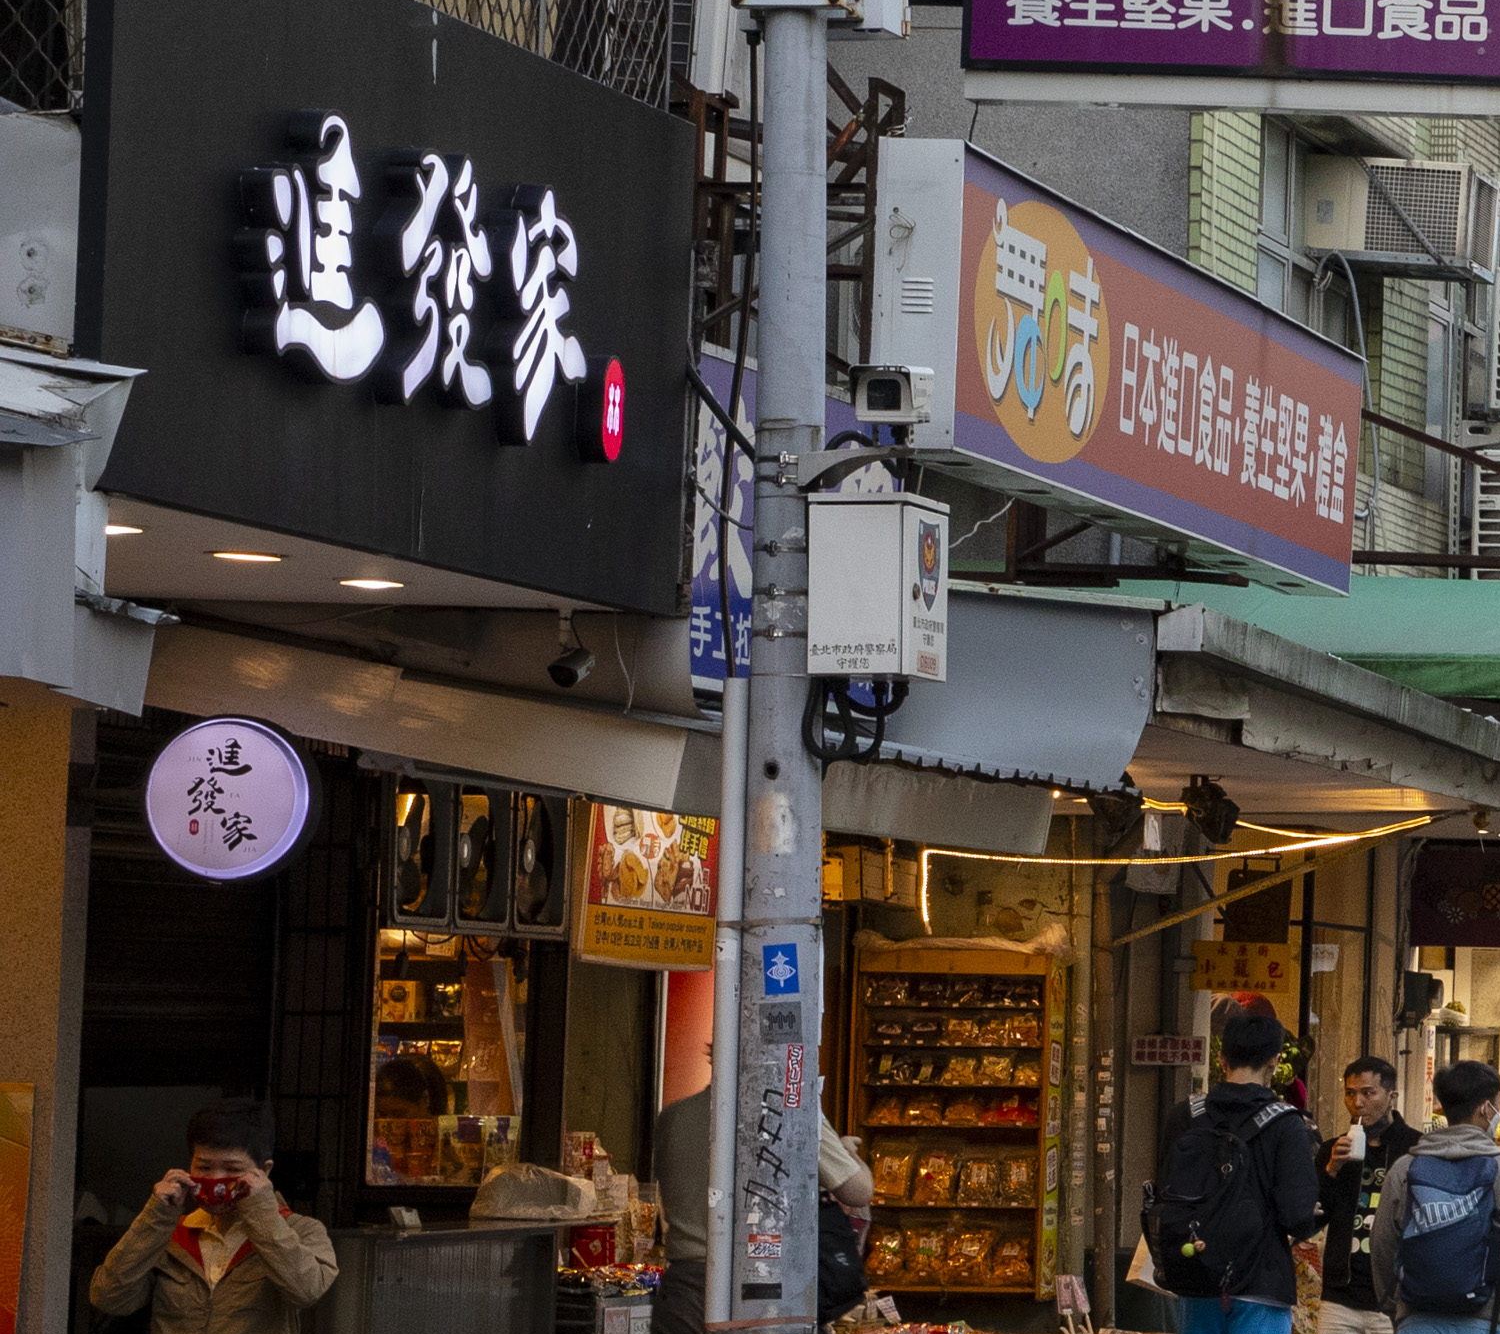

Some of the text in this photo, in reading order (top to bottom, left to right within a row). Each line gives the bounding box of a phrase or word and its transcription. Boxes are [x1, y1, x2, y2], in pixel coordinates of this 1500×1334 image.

[809, 641, 897, 656] 臺北市政府警察局
